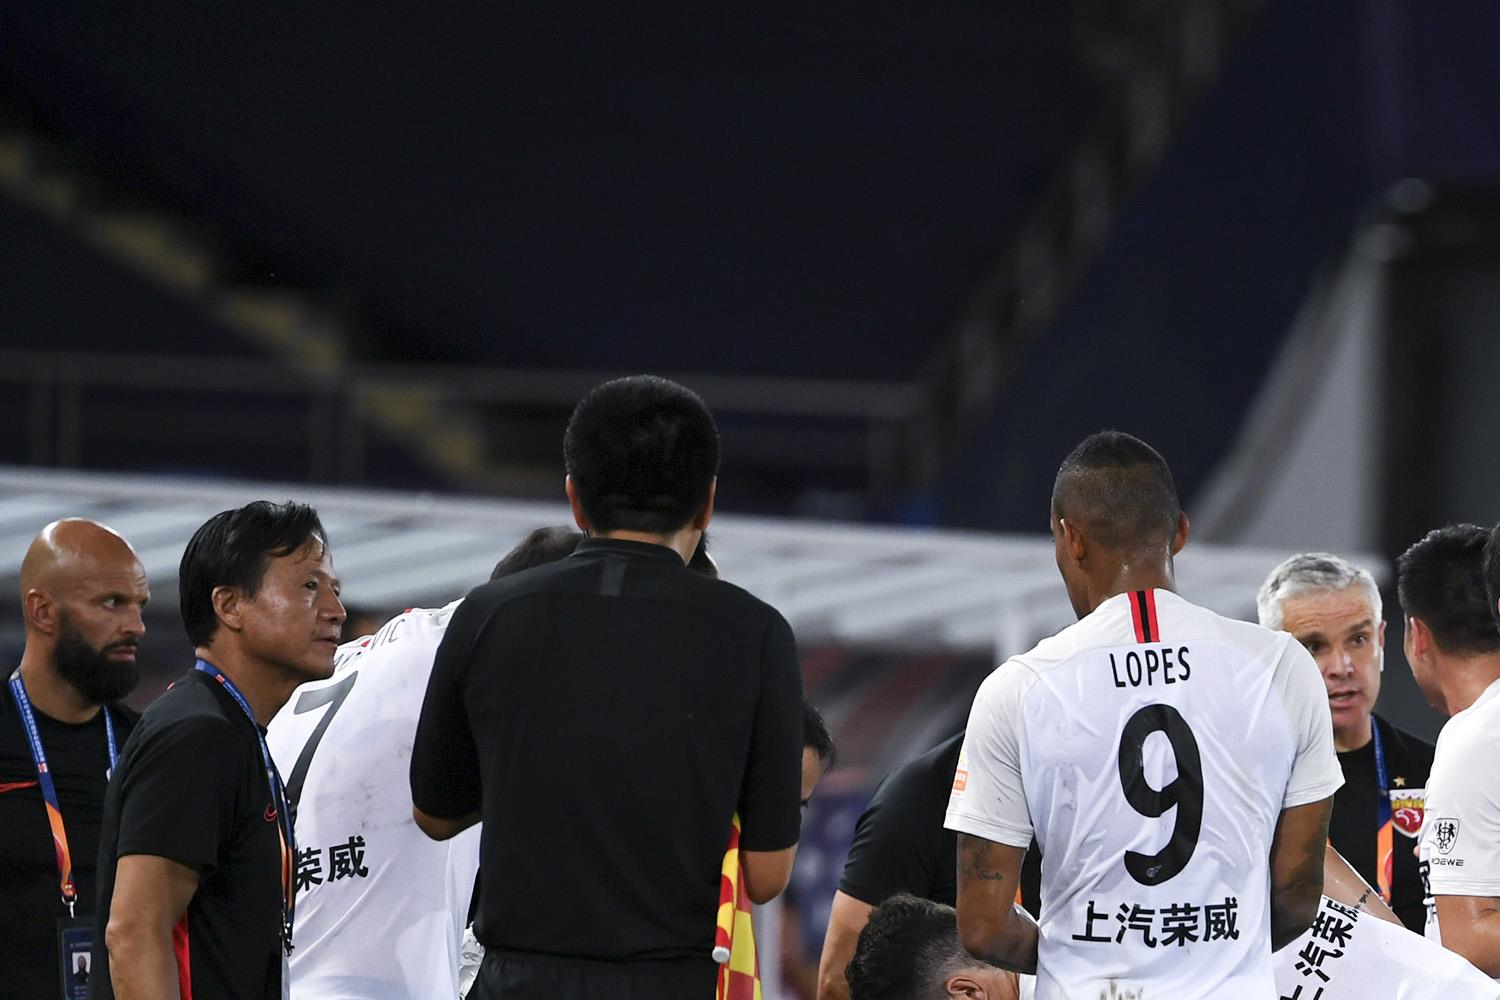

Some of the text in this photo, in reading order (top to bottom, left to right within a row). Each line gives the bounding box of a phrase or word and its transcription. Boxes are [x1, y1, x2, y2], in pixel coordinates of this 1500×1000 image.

[1109, 646, 1191, 688] LOPES
[293, 670, 358, 829] 7
[1118, 703, 1204, 886] 9
[1072, 897, 1240, 949] 上汽荣威
